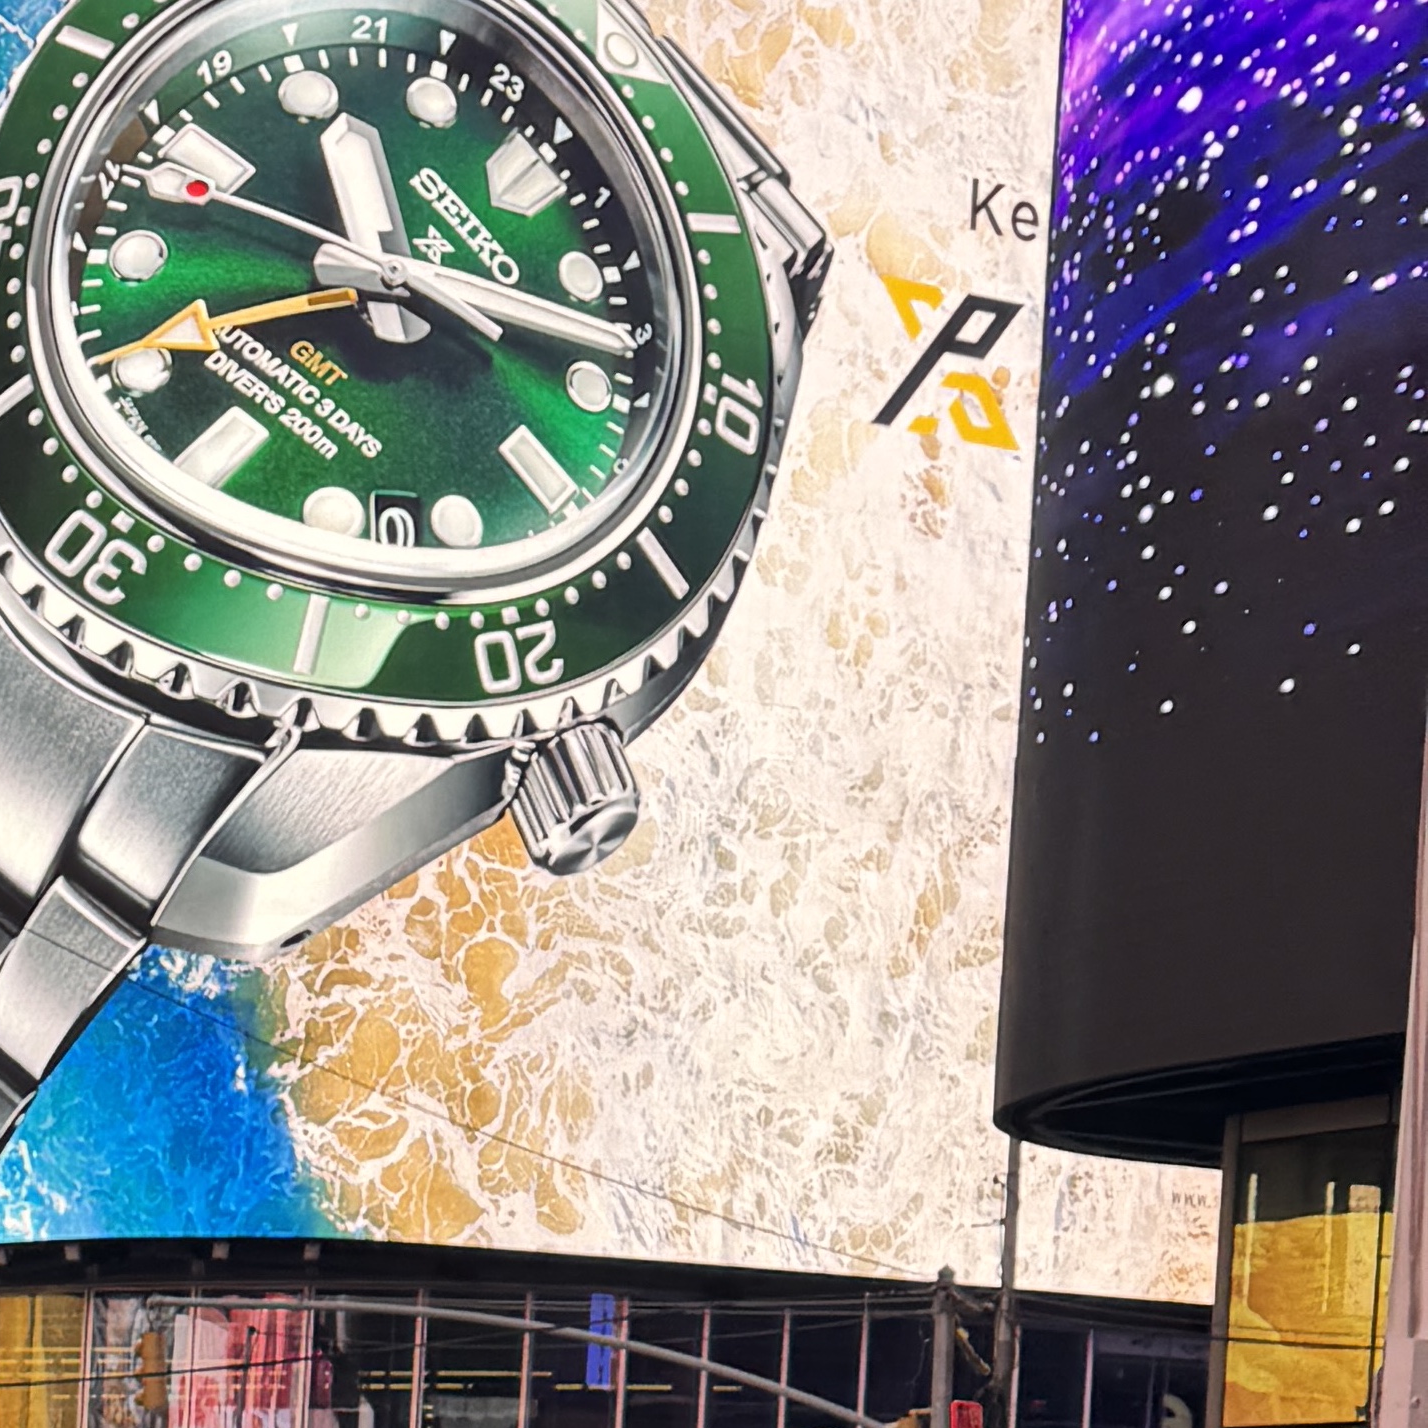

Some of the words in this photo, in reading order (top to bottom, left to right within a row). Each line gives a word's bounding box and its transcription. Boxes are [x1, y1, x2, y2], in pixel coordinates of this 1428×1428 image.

[351, 15, 388, 43] 21
[197, 50, 232, 84] 19
[489, 63, 525, 102] 23
[98, 159, 120, 200] 17
[408, 167, 520, 286] SEIKO
[289, 340, 348, 387] GMT
[204, 349, 287, 416] DIVER'S
[278, 406, 340, 461] 200m
[316, 398, 336, 418] 3
[327, 409, 383, 459] DAYS
[715, 373, 764, 456] 10
[44, 509, 147, 605] 30
[474, 619, 565, 695] 20
